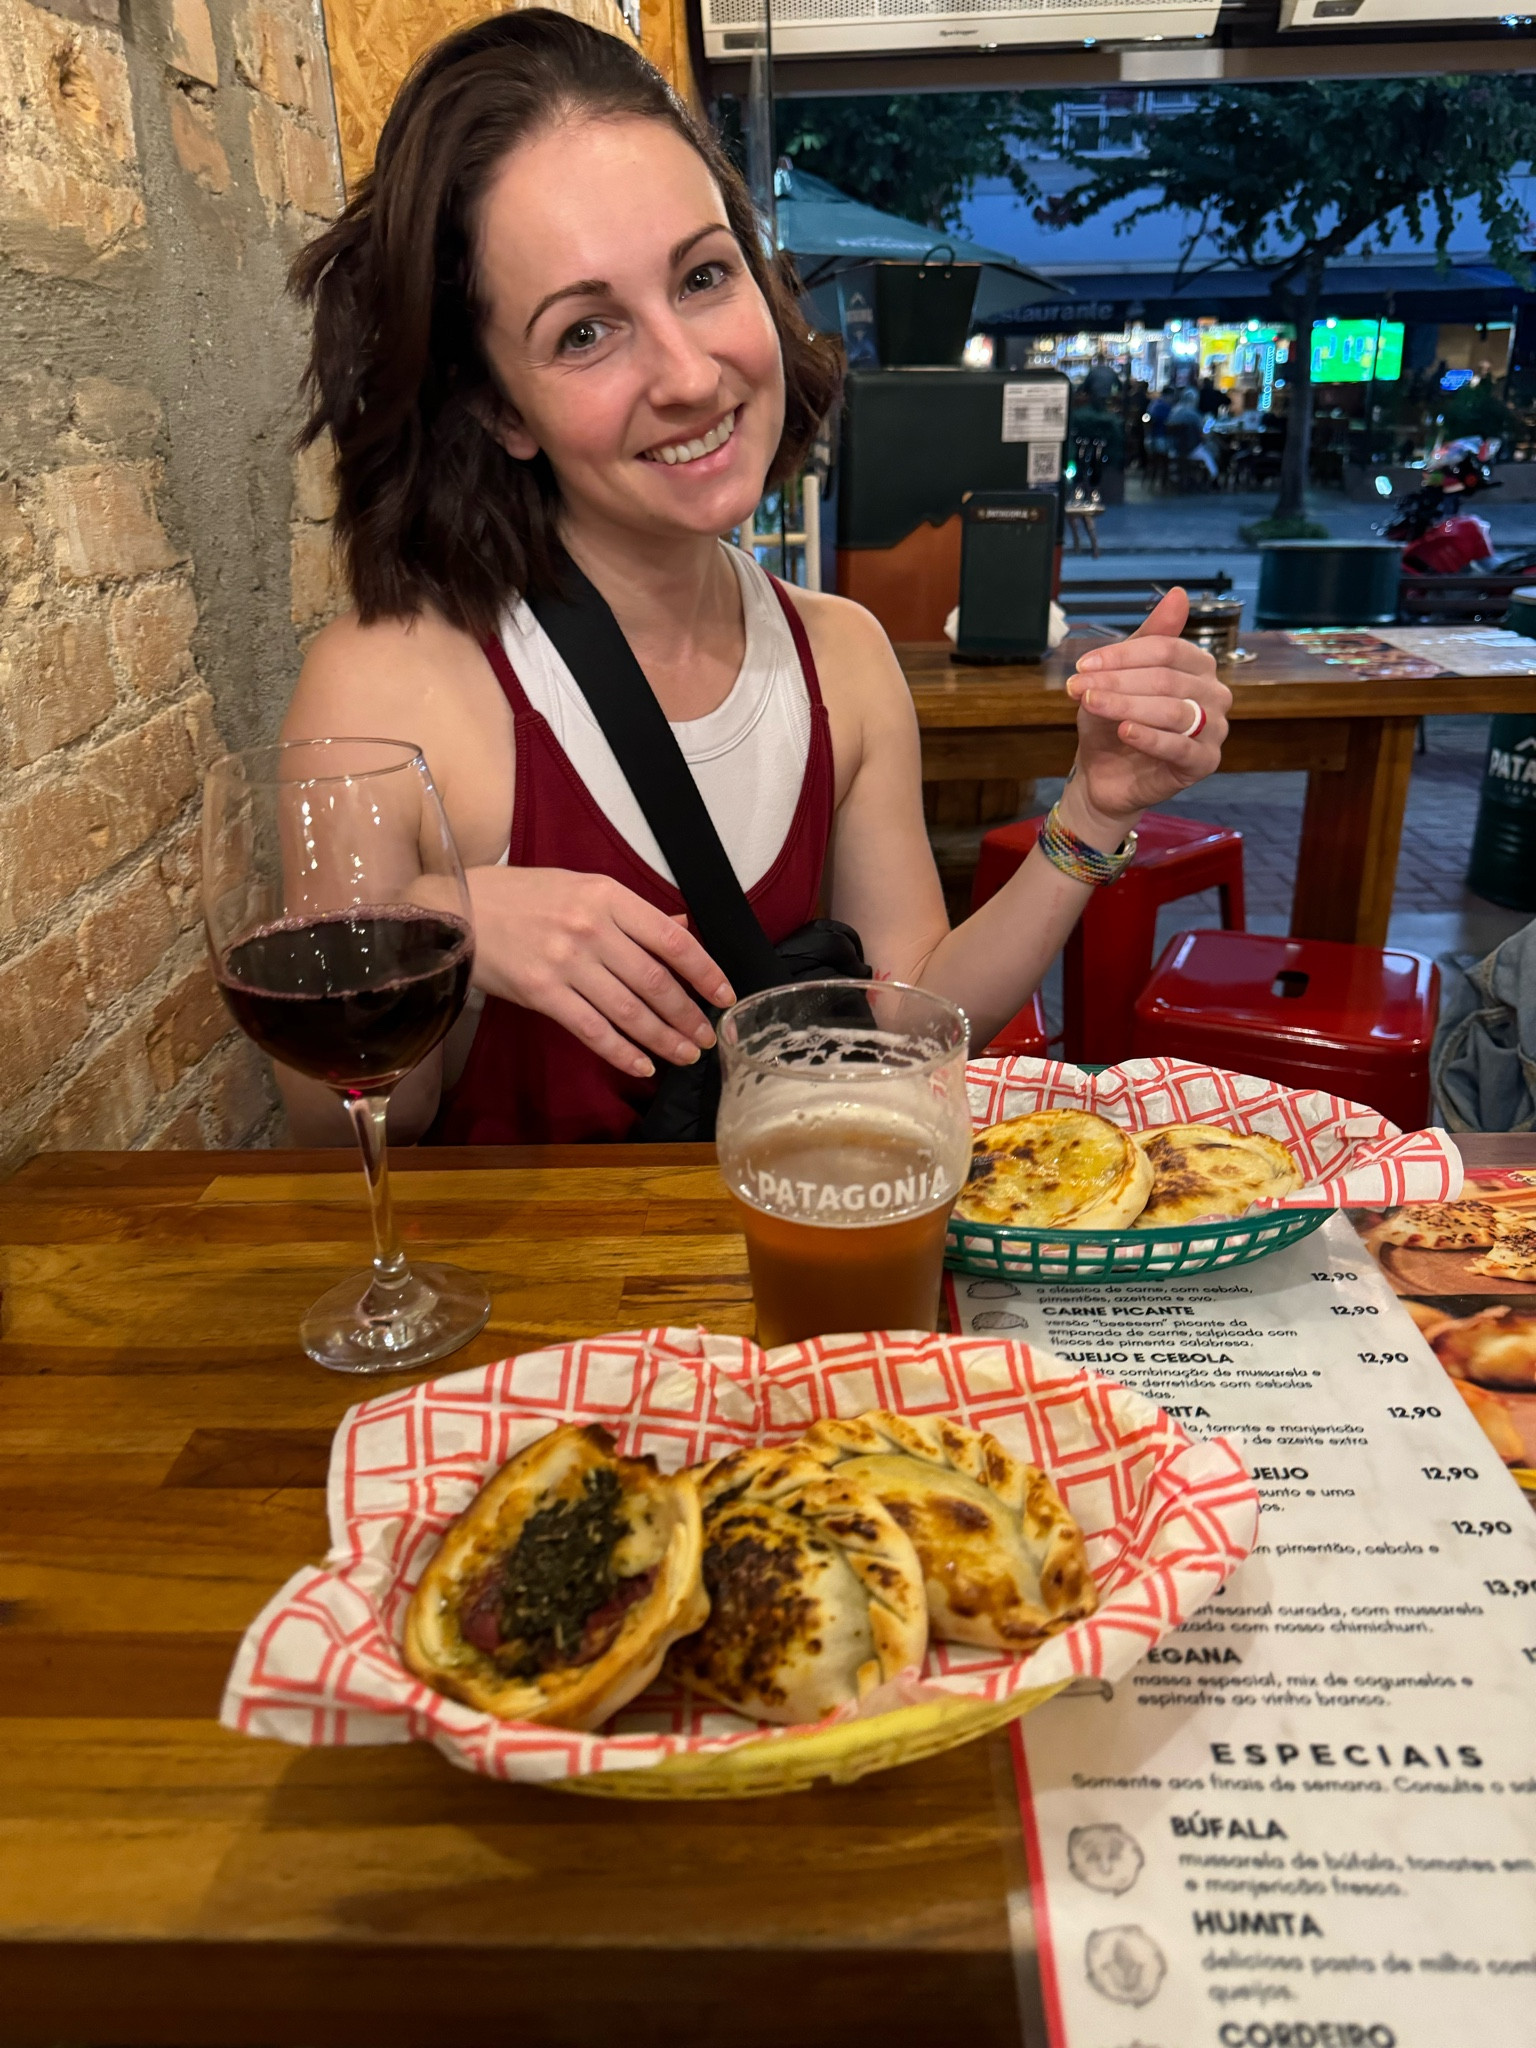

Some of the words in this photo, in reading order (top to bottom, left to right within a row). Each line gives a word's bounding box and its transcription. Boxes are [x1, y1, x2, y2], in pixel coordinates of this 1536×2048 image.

[758, 1165, 947, 1211] PATAGONIA
[1311, 1272, 1358, 1283] 12,90
[1105, 1285, 1122, 1294] de
[1126, 1286, 1167, 1295] carne,
[1172, 1286, 1200, 1294] com
[1203, 1284, 1254, 1295] cebola,
[1039, 1294, 1111, 1304] pimentões,
[1114, 1294, 1172, 1303] azeitona
[1042, 1306, 1108, 1317] CARNE
[1112, 1306, 1196, 1317] PICANTE
[1330, 1305, 1380, 1316] 12,90
[1045, 1318, 1090, 1328] versão
[1173, 1319, 1226, 1330] picante
[1229, 1318, 1248, 1328] da
[1048, 1329, 1122, 1339] empanada
[1129, 1328, 1145, 1338] de
[1148, 1329, 1192, 1338] carne,
[1195, 1328, 1264, 1339] salpicada
[1267, 1329, 1298, 1338] com
[1050, 1337, 1094, 1347] flocos
[1096, 1337, 1114, 1347] de
[1118, 1338, 1176, 1348] pimenta
[1180, 1338, 1254, 1348] calabresa.
[1133, 1352, 1146, 1363] E
[1150, 1352, 1235, 1364] CEBOLA
[1357, 1352, 1409, 1365] 12,90
[1119, 1367, 1209, 1378] combinação
[1214, 1367, 1232, 1378] de
[1235, 1367, 1308, 1378] mussarela
[1312, 1370, 1321, 1378] e
[1141, 1378, 1217, 1389] derretidos
[1219, 1379, 1251, 1389] com
[1255, 1378, 1313, 1389] cebolas
[1387, 1405, 1442, 1420] 12,90
[1205, 1423, 1262, 1433] tomate
[1265, 1425, 1275, 1433] e
[1280, 1423, 1365, 1435] manjericão
[1252, 1434, 1272, 1445] de
[1277, 1435, 1324, 1445] azeite
[1328, 1436, 1369, 1446] extra
[1421, 1467, 1479, 1482] 12,90
[1305, 1489, 1316, 1497] e
[1320, 1488, 1356, 1497] uma
[1452, 1520, 1513, 1537] 12,90
[1275, 1542, 1361, 1557] pimentão,
[1365, 1541, 1424, 1555] cebola
[1428, 1545, 1440, 1555] e
[1278, 1602, 1347, 1618] curada,
[1351, 1605, 1390, 1617] com
[1394, 1602, 1484, 1616] mussarela
[1230, 1621, 1269, 1634] com
[1274, 1622, 1325, 1634] nosso
[1138, 1647, 1242, 1664] EGANA
[1133, 1674, 1192, 1687] massa
[1197, 1671, 1282, 1690] especial,
[1287, 1673, 1317, 1687] mix
[1323, 1671, 1349, 1687] de
[1354, 1670, 1457, 1692] cogumelos
[1461, 1676, 1474, 1687] e
[1137, 1689, 1226, 1709] espinafre
[1231, 1693, 1257, 1706] ao
[1262, 1690, 1312, 1706] vinho
[1209, 1743, 1484, 1768] ESPECIAIS
[1071, 1773, 1162, 1790] Somente
[1210, 1773, 1265, 1792] finais
[1269, 1774, 1297, 1792] de
[1170, 1810, 1288, 1840] BÚFALA
[1192, 1909, 1325, 1938] HUMITA
[1217, 2021, 1398, 2048] CORDEIRO
